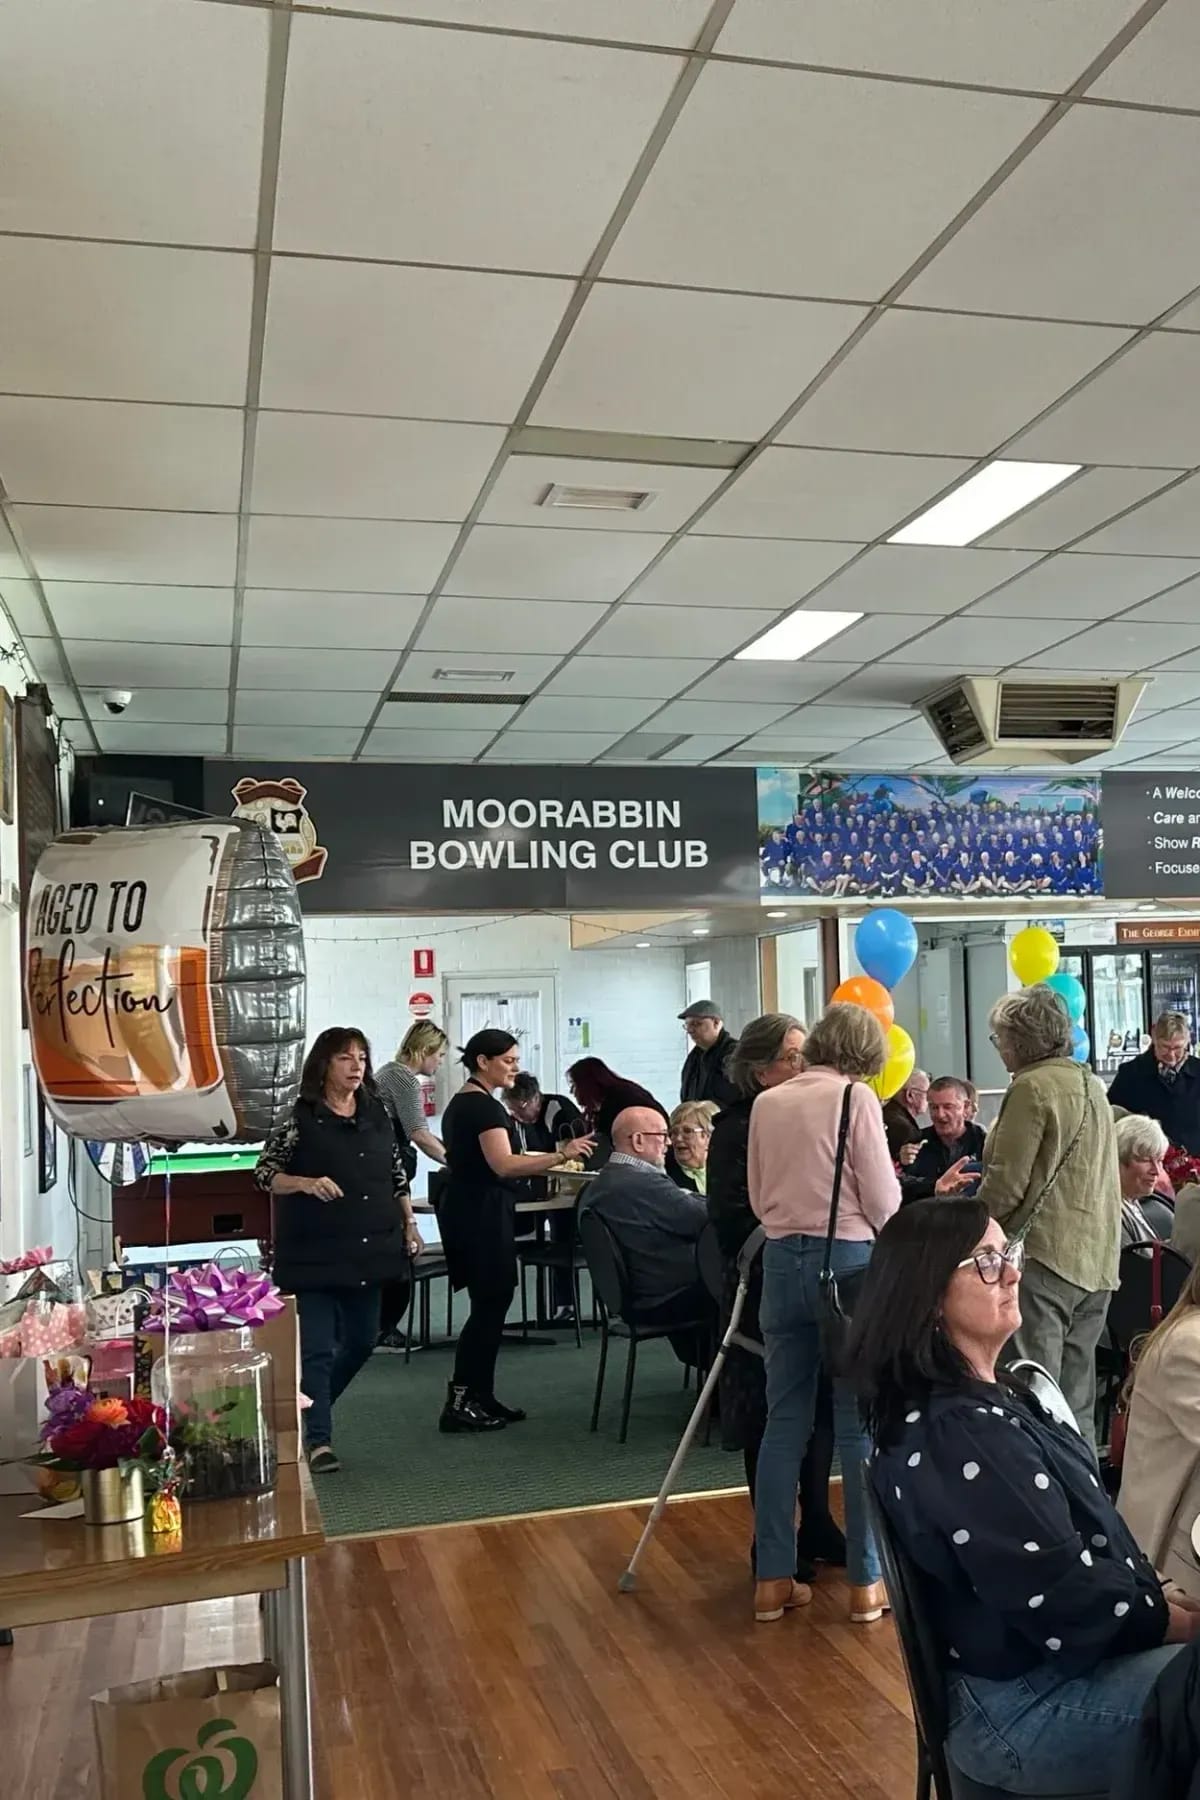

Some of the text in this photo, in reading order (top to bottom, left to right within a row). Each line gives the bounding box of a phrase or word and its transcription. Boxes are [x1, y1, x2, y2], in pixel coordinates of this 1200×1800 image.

[1153, 787, 1162, 799] A
[443, 799, 681, 829] MOORABBIN
[1153, 811, 1184, 824] Care
[1154, 836, 1188, 849] Show
[410, 840, 709, 870] BOWLING CLUB
[35, 880, 147, 937] AGED TO
